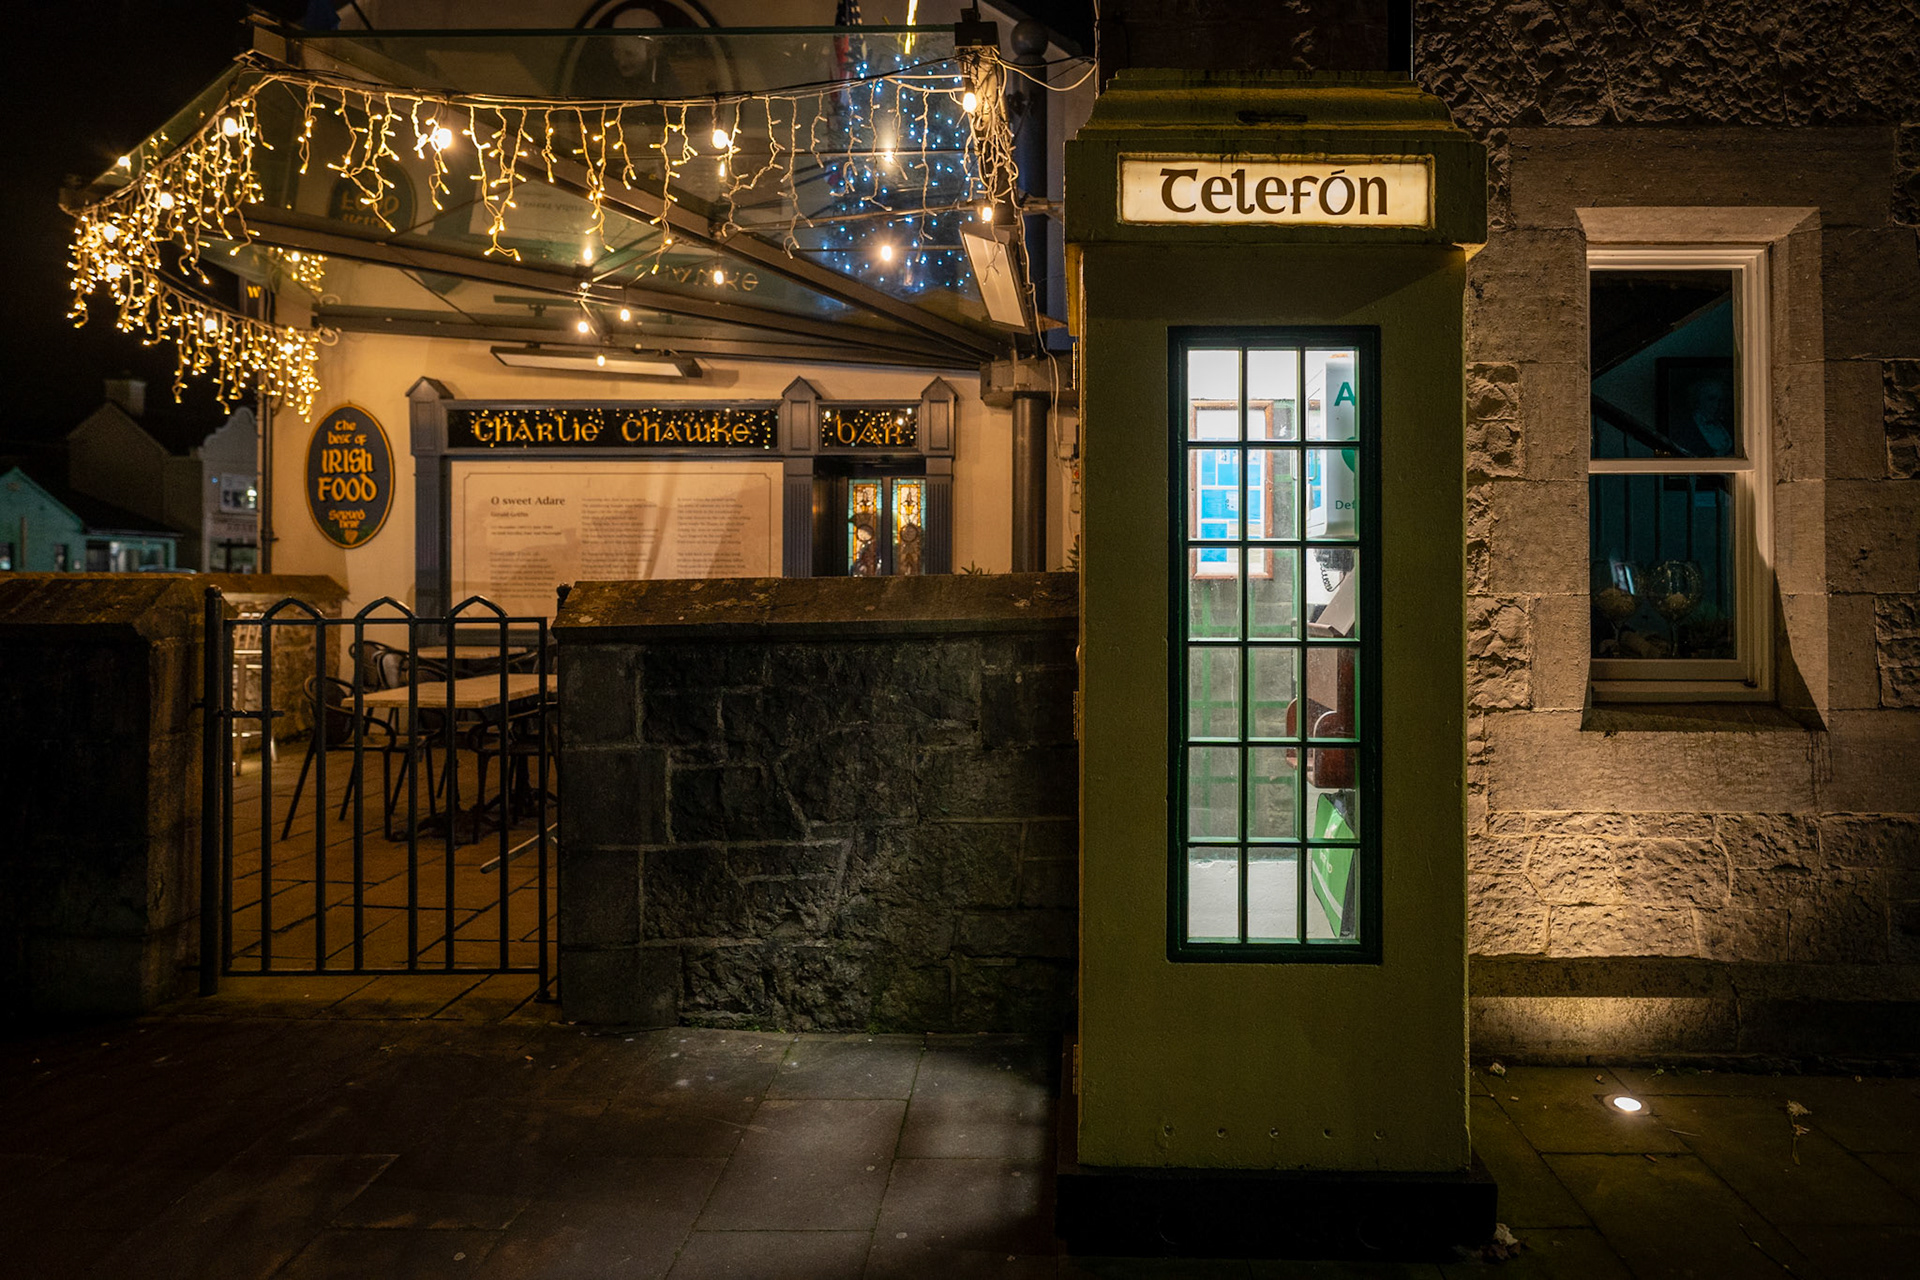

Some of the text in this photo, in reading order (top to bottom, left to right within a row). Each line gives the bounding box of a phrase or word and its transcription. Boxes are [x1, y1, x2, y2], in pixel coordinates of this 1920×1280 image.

[1159, 167, 1389, 216] Telefón
[318, 473, 378, 502] FOOD
[490, 496, 566, 506] O sweet Adare
